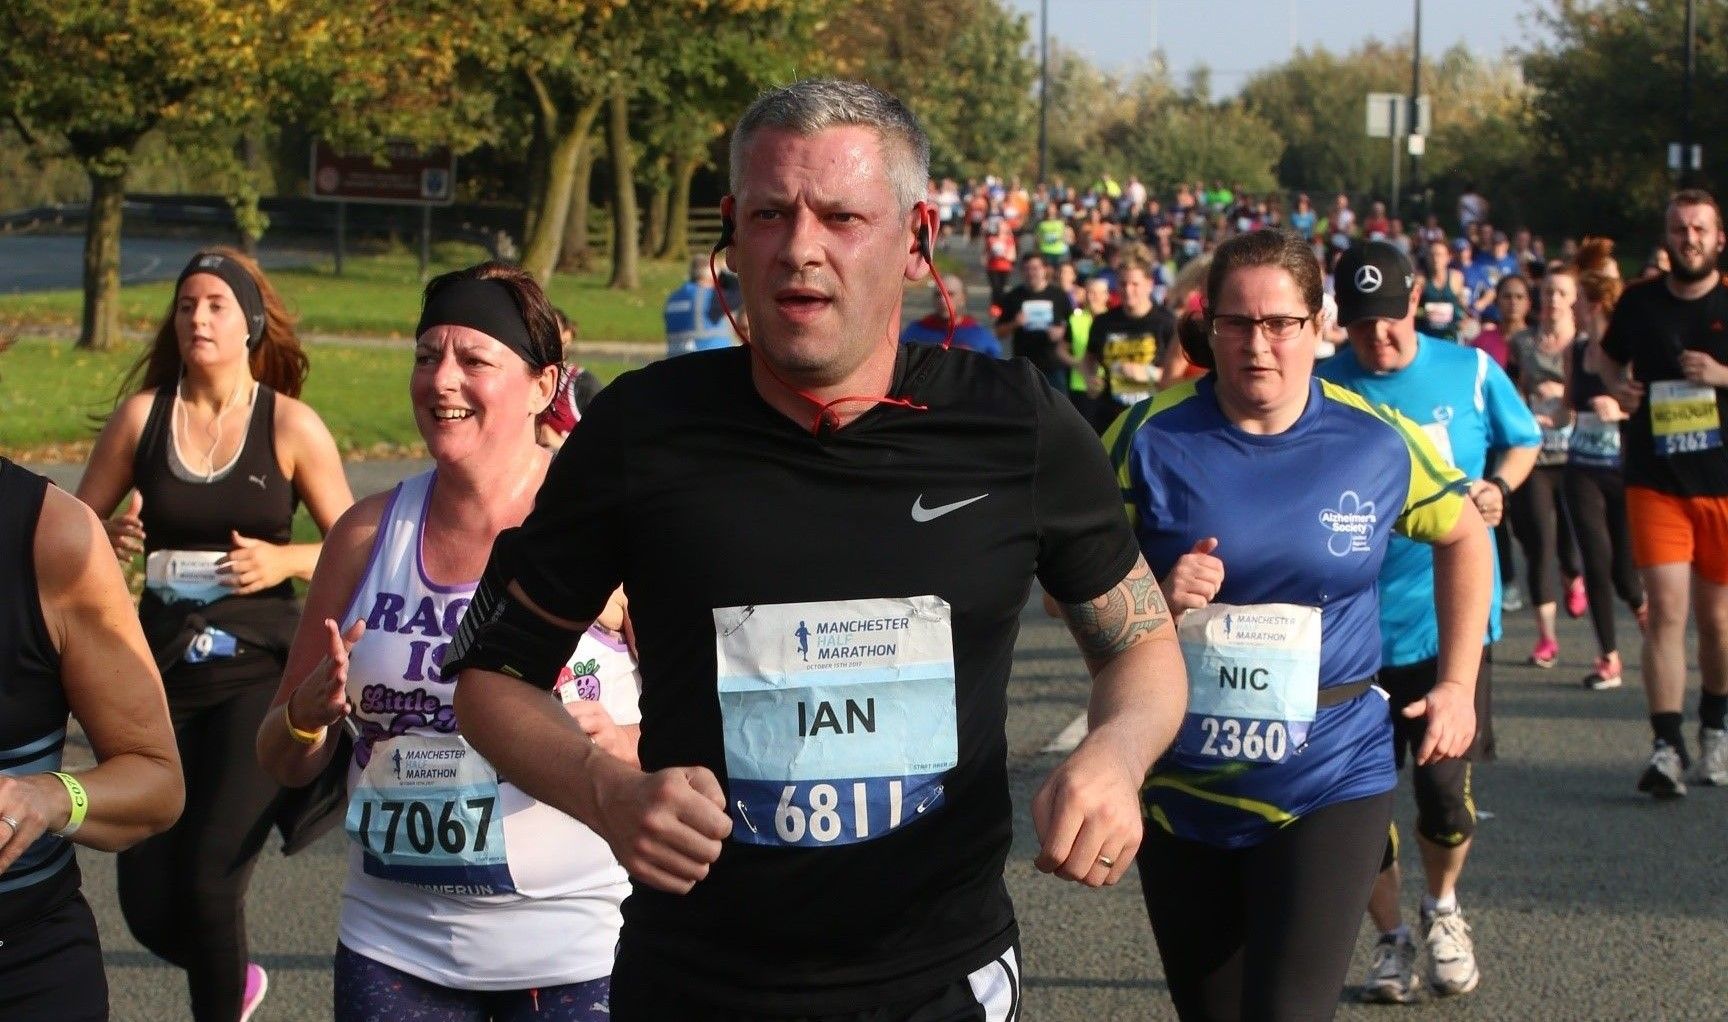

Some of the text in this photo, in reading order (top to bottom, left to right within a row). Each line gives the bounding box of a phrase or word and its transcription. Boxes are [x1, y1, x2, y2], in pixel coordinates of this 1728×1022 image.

[1332, 522, 1367, 535] Society
[816, 617, 909, 634] MANCHESTER
[1237, 615, 1297, 625] MANCHESTER
[817, 633, 853, 647] HALF
[1236, 632, 1287, 642] MARATHON
[818, 644, 897, 660] MARATHON
[806, 663, 833, 671] OCTOBER
[1220, 666, 1269, 691] NIC
[360, 683, 440, 715] Little
[797, 697, 876, 737] IAN
[1200, 717, 1287, 761] 2360
[405, 750, 466, 761] MANCHESTER
[405, 761, 426, 769] HALF
[405, 768, 457, 779] MARATHON
[774, 780, 903, 842] 6811
[358, 797, 496, 854] 17067
